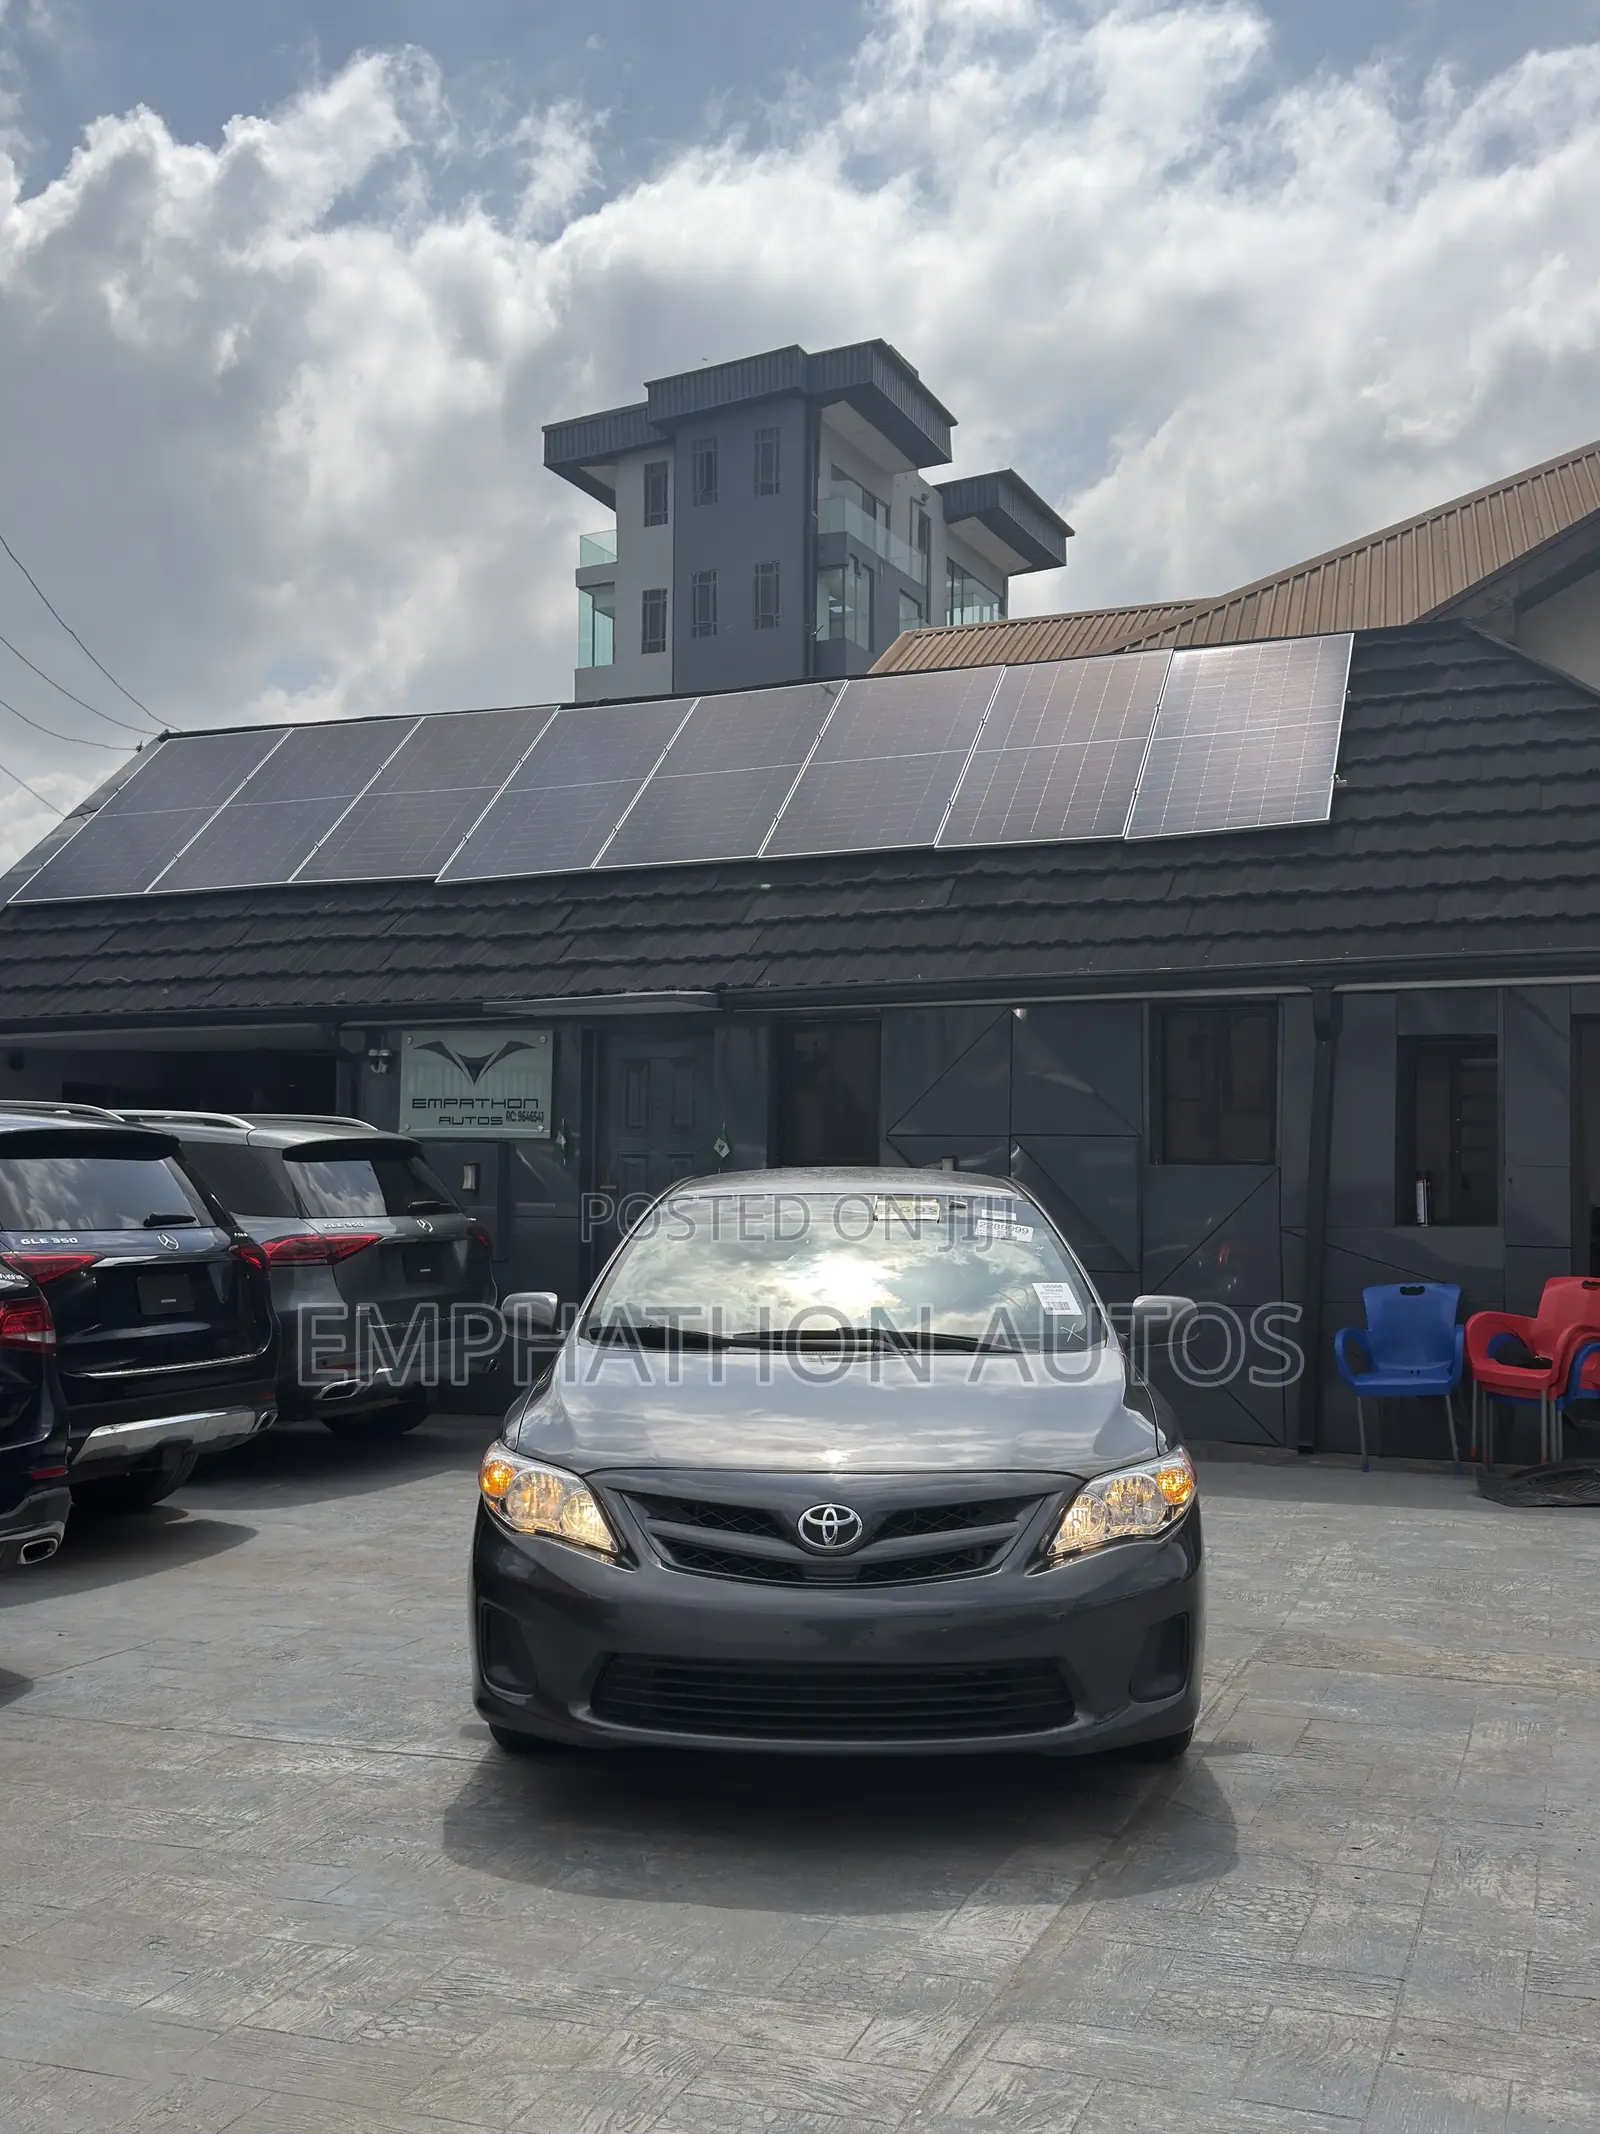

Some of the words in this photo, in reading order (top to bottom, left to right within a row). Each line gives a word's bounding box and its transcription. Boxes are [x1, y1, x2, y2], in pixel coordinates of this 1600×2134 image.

[411, 1098, 539, 1109] EMPATHON
[438, 1116, 503, 1125] AUTOS
[21, 1237, 50, 1245] GLE
